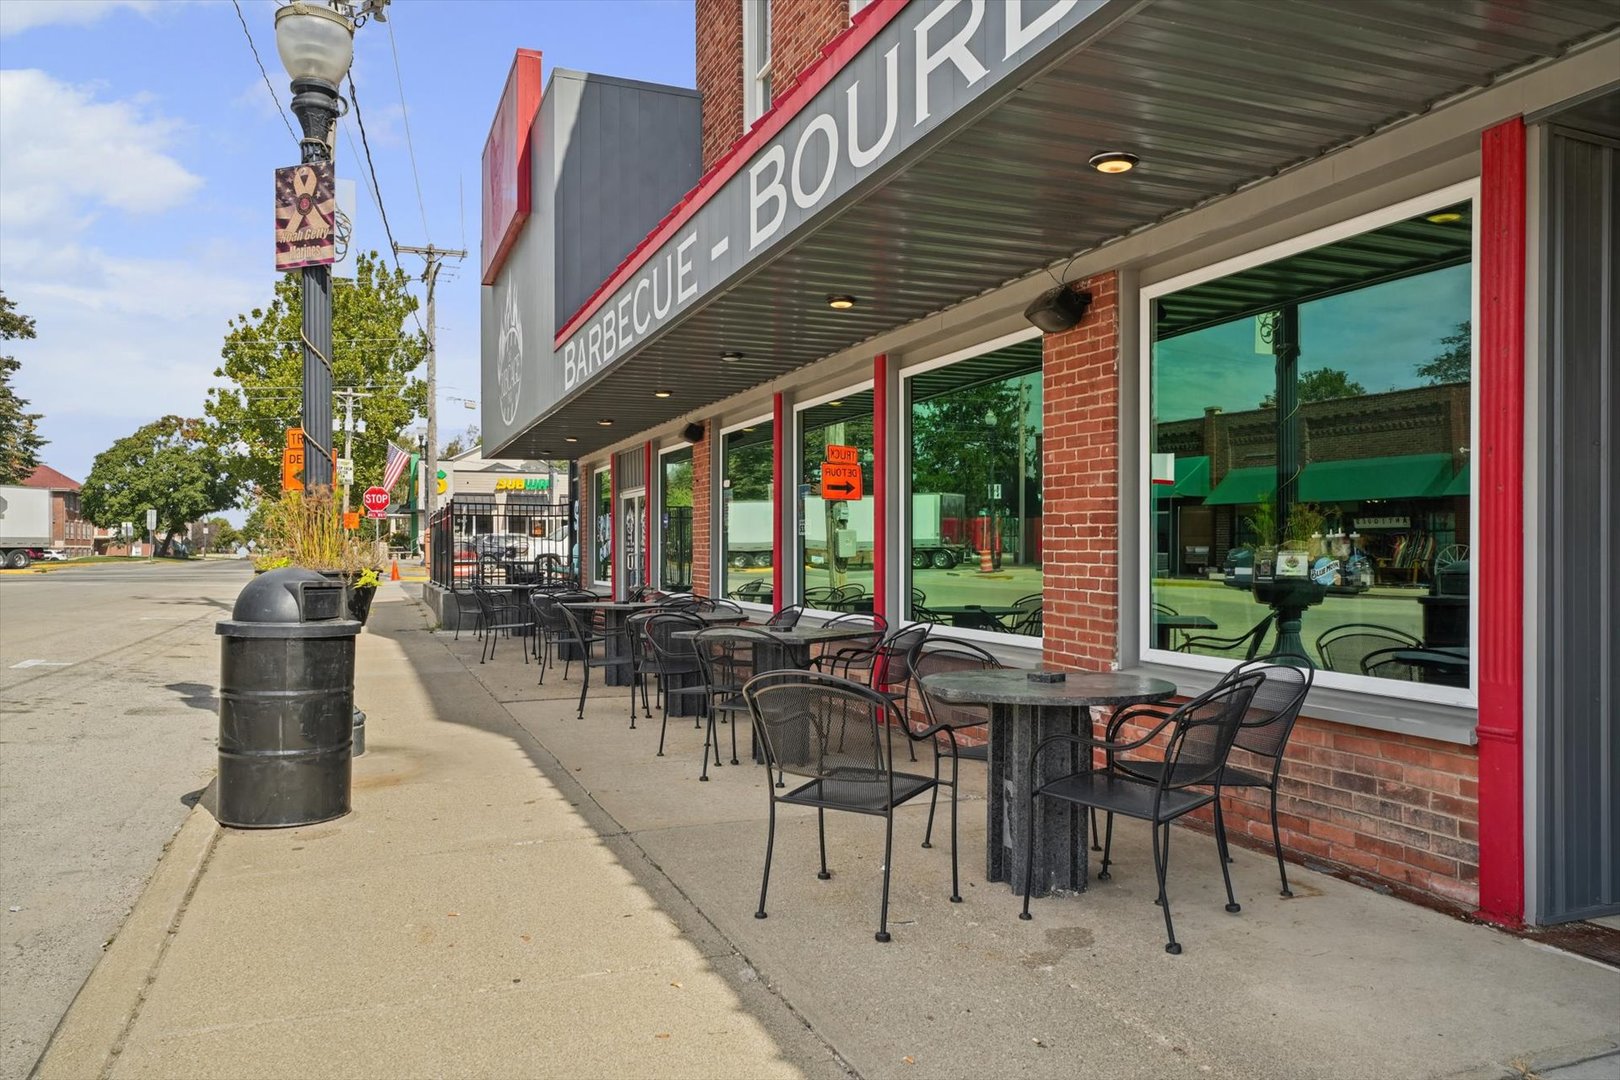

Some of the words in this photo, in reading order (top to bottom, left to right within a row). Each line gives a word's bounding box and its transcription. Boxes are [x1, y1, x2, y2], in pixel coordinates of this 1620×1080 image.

[564, 231, 698, 391] BARBECUE
[496, 478, 550, 490] SUBWA
[365, 494, 388, 504] STOP
